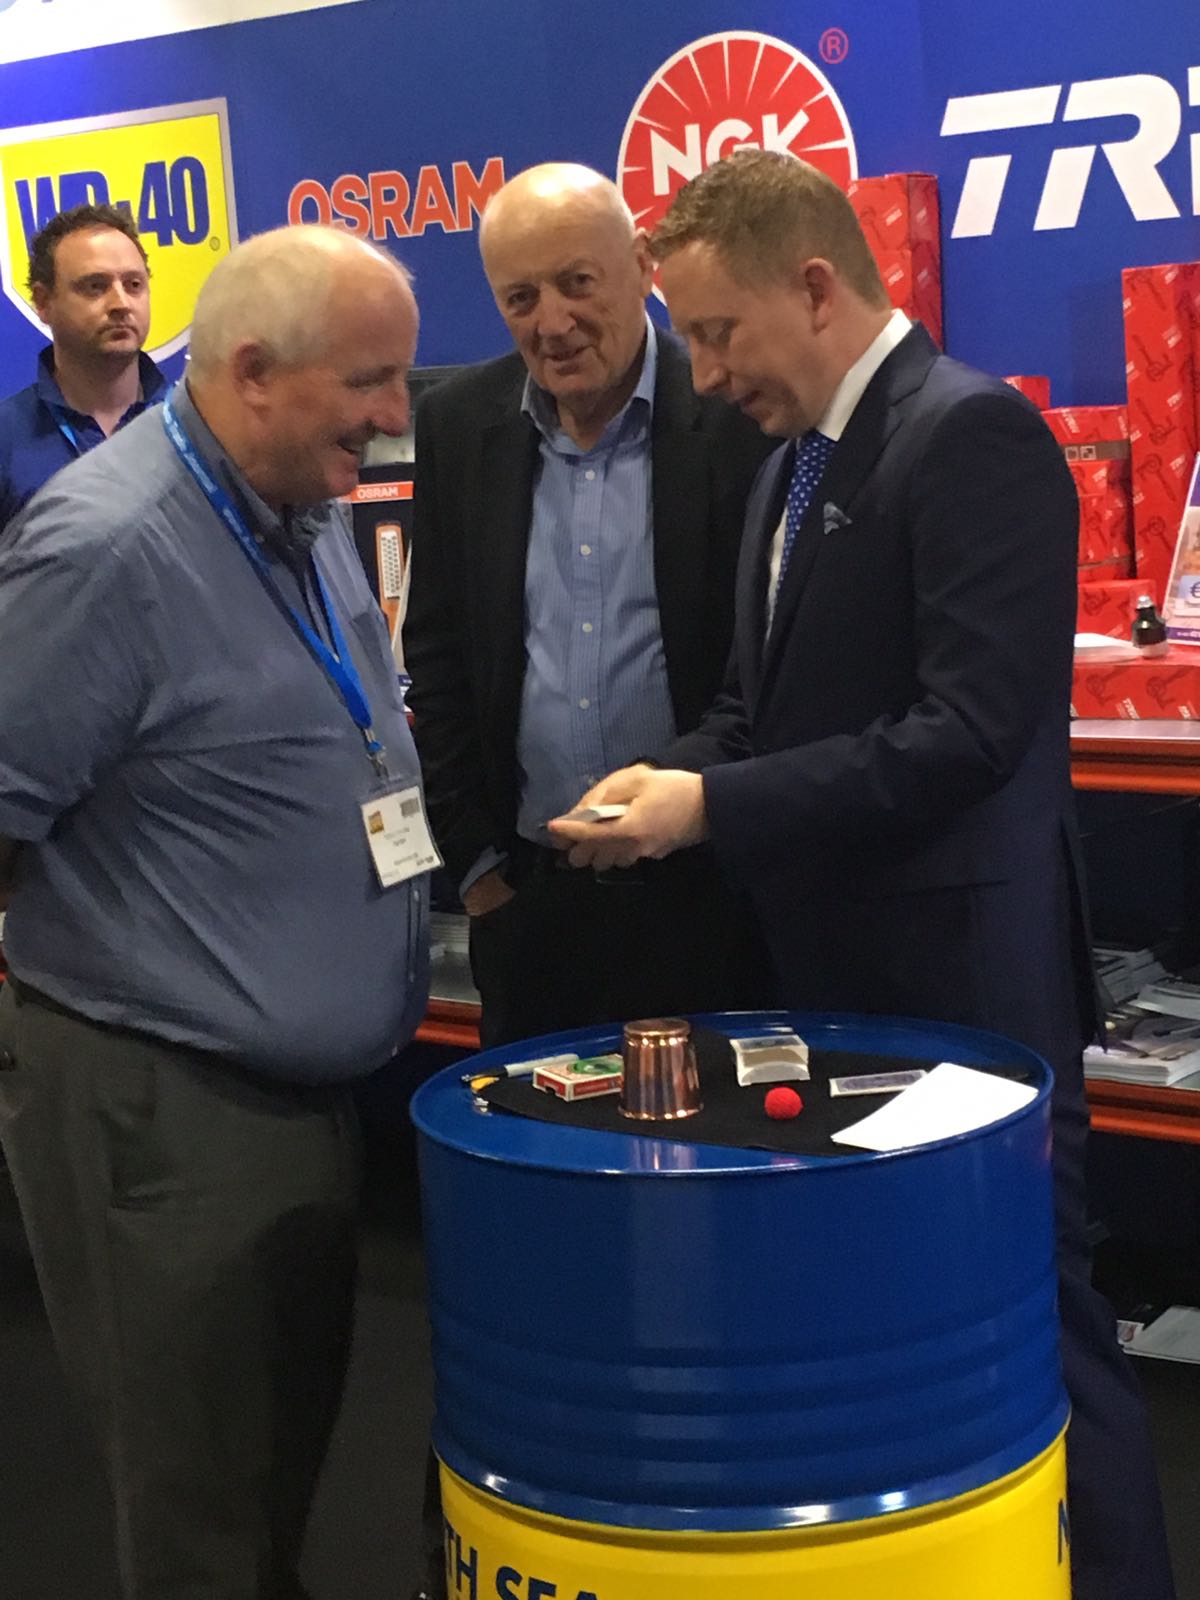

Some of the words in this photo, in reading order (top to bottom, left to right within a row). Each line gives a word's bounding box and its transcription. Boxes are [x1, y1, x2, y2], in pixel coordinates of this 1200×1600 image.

[940, 66, 1200, 239] TR
[288, 157, 505, 240] OSRAM
[357, 487, 399, 499] OSRAM
